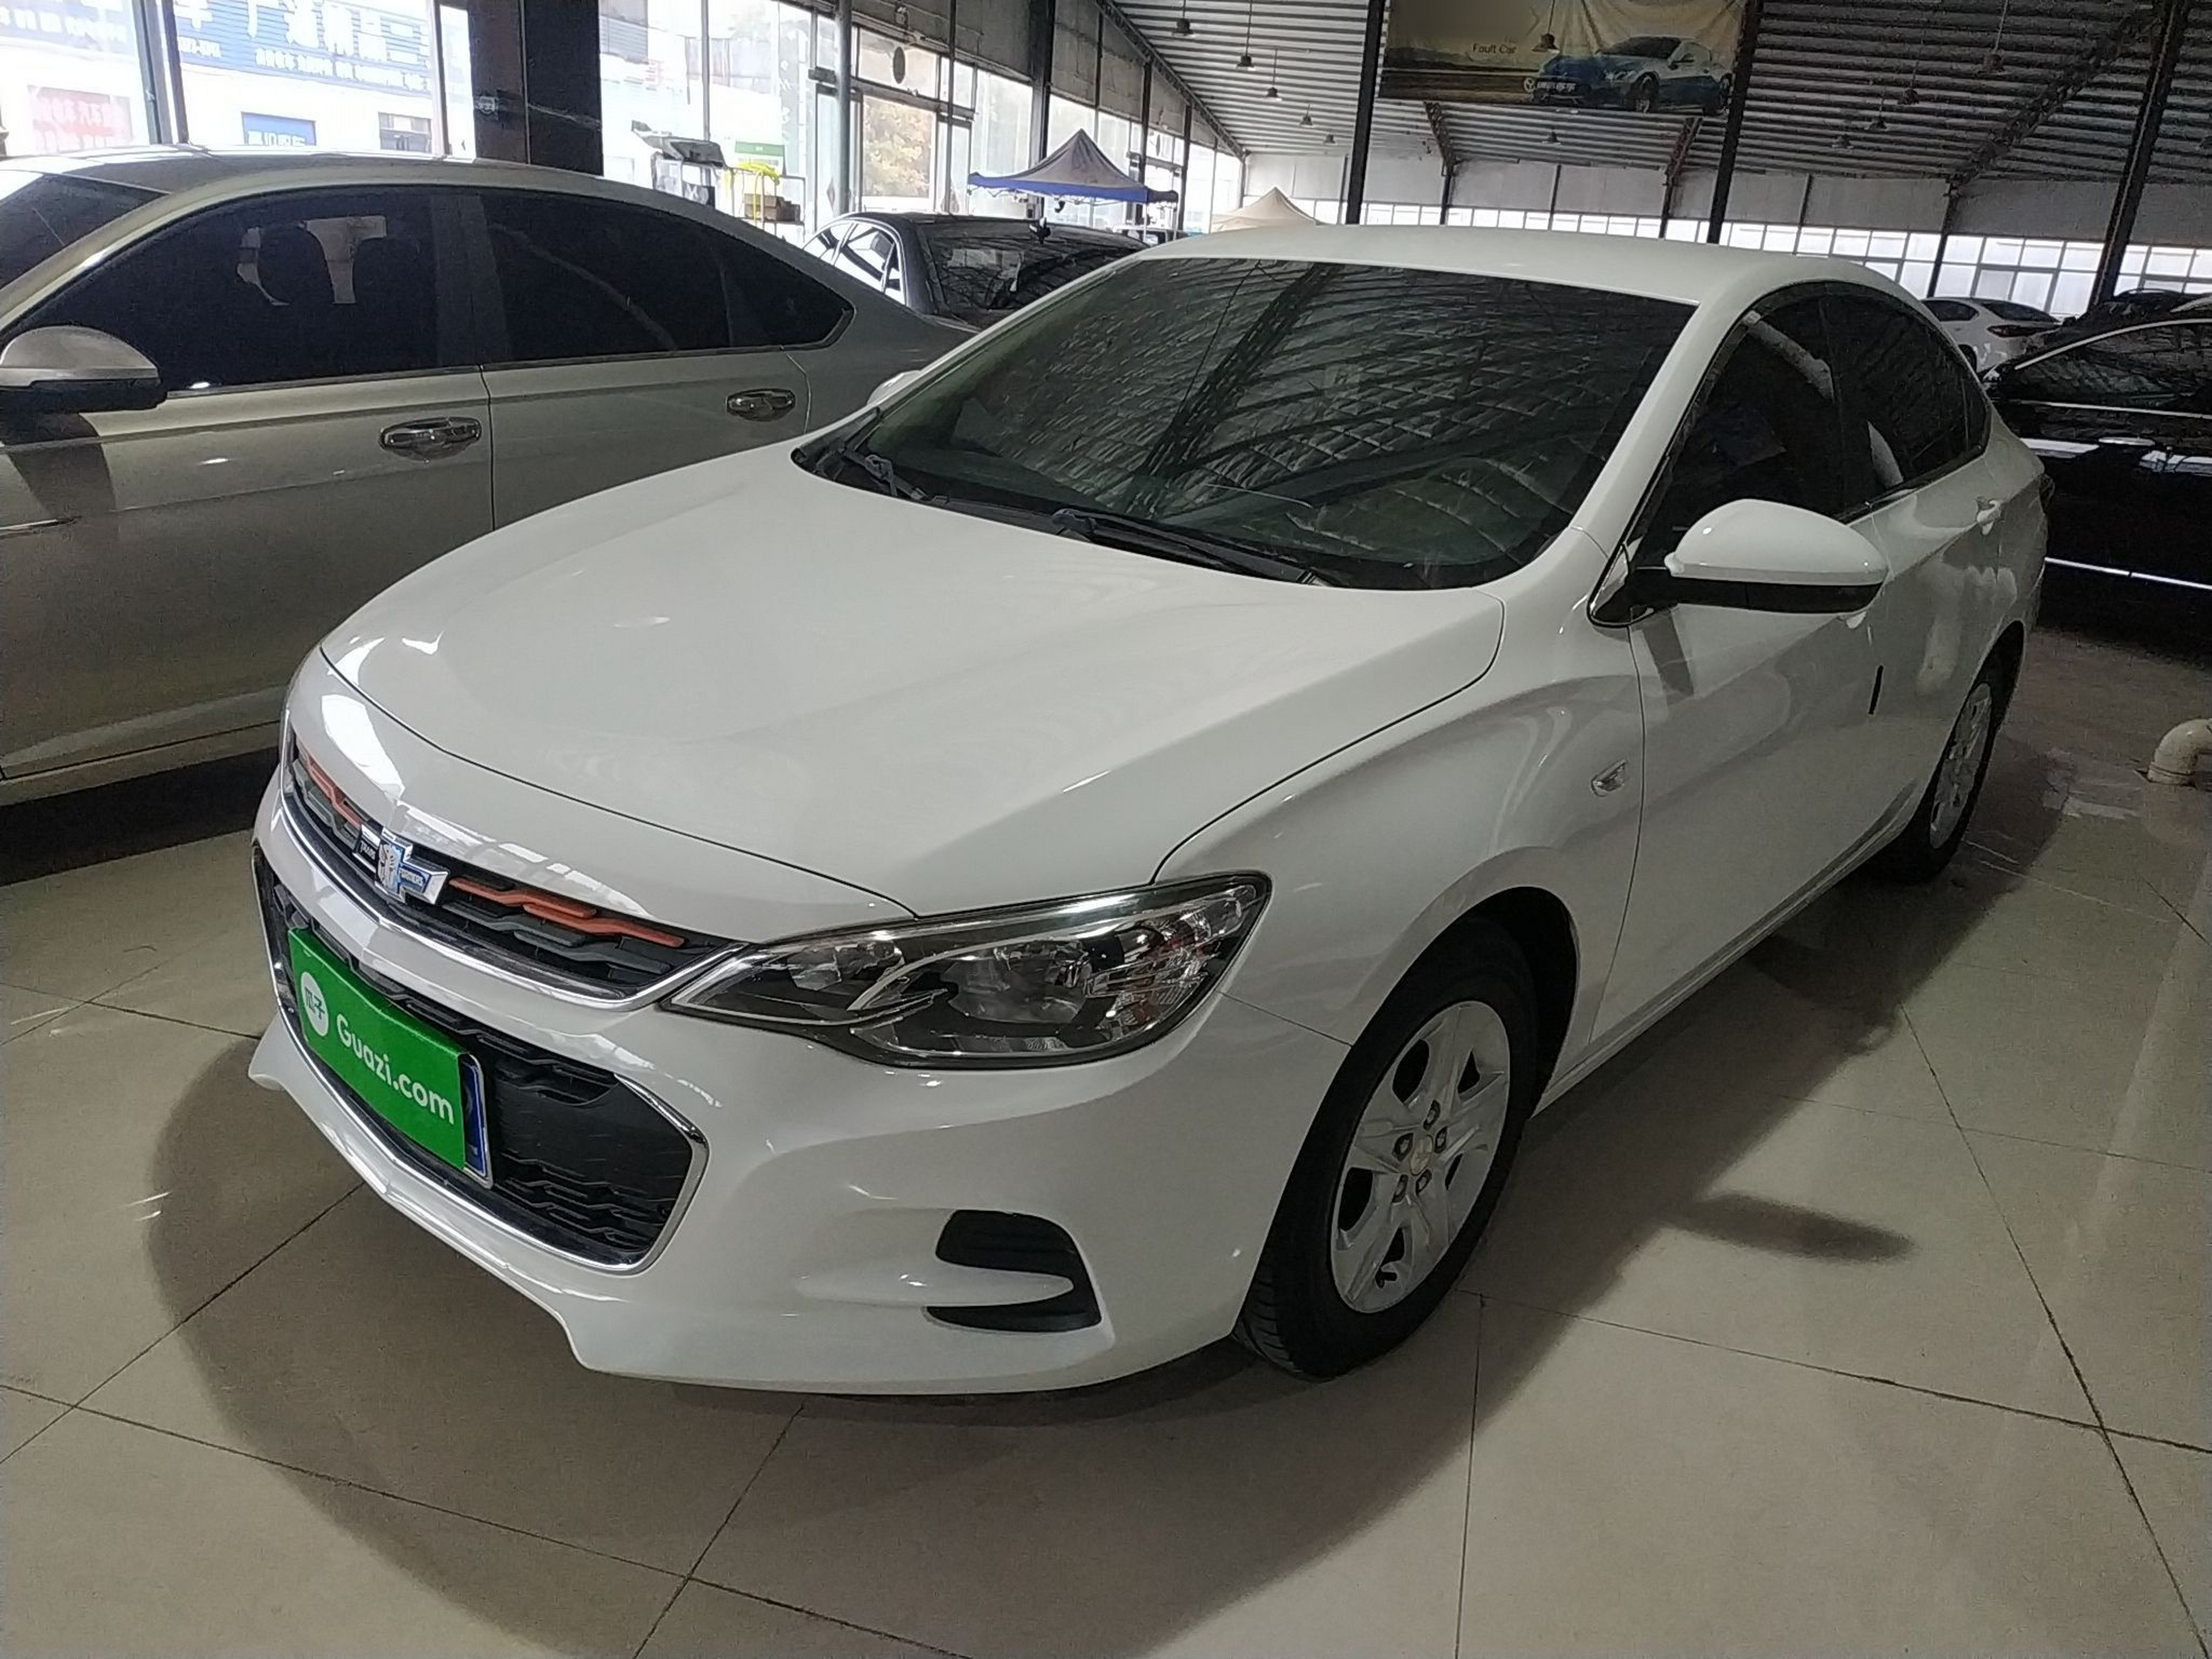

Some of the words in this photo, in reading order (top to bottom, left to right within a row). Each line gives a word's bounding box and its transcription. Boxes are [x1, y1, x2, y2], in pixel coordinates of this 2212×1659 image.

[1499, 44, 1517, 54] Car
[305, 986, 325, 1020] 瓜子
[336, 1013, 454, 1125] Guazi.com
